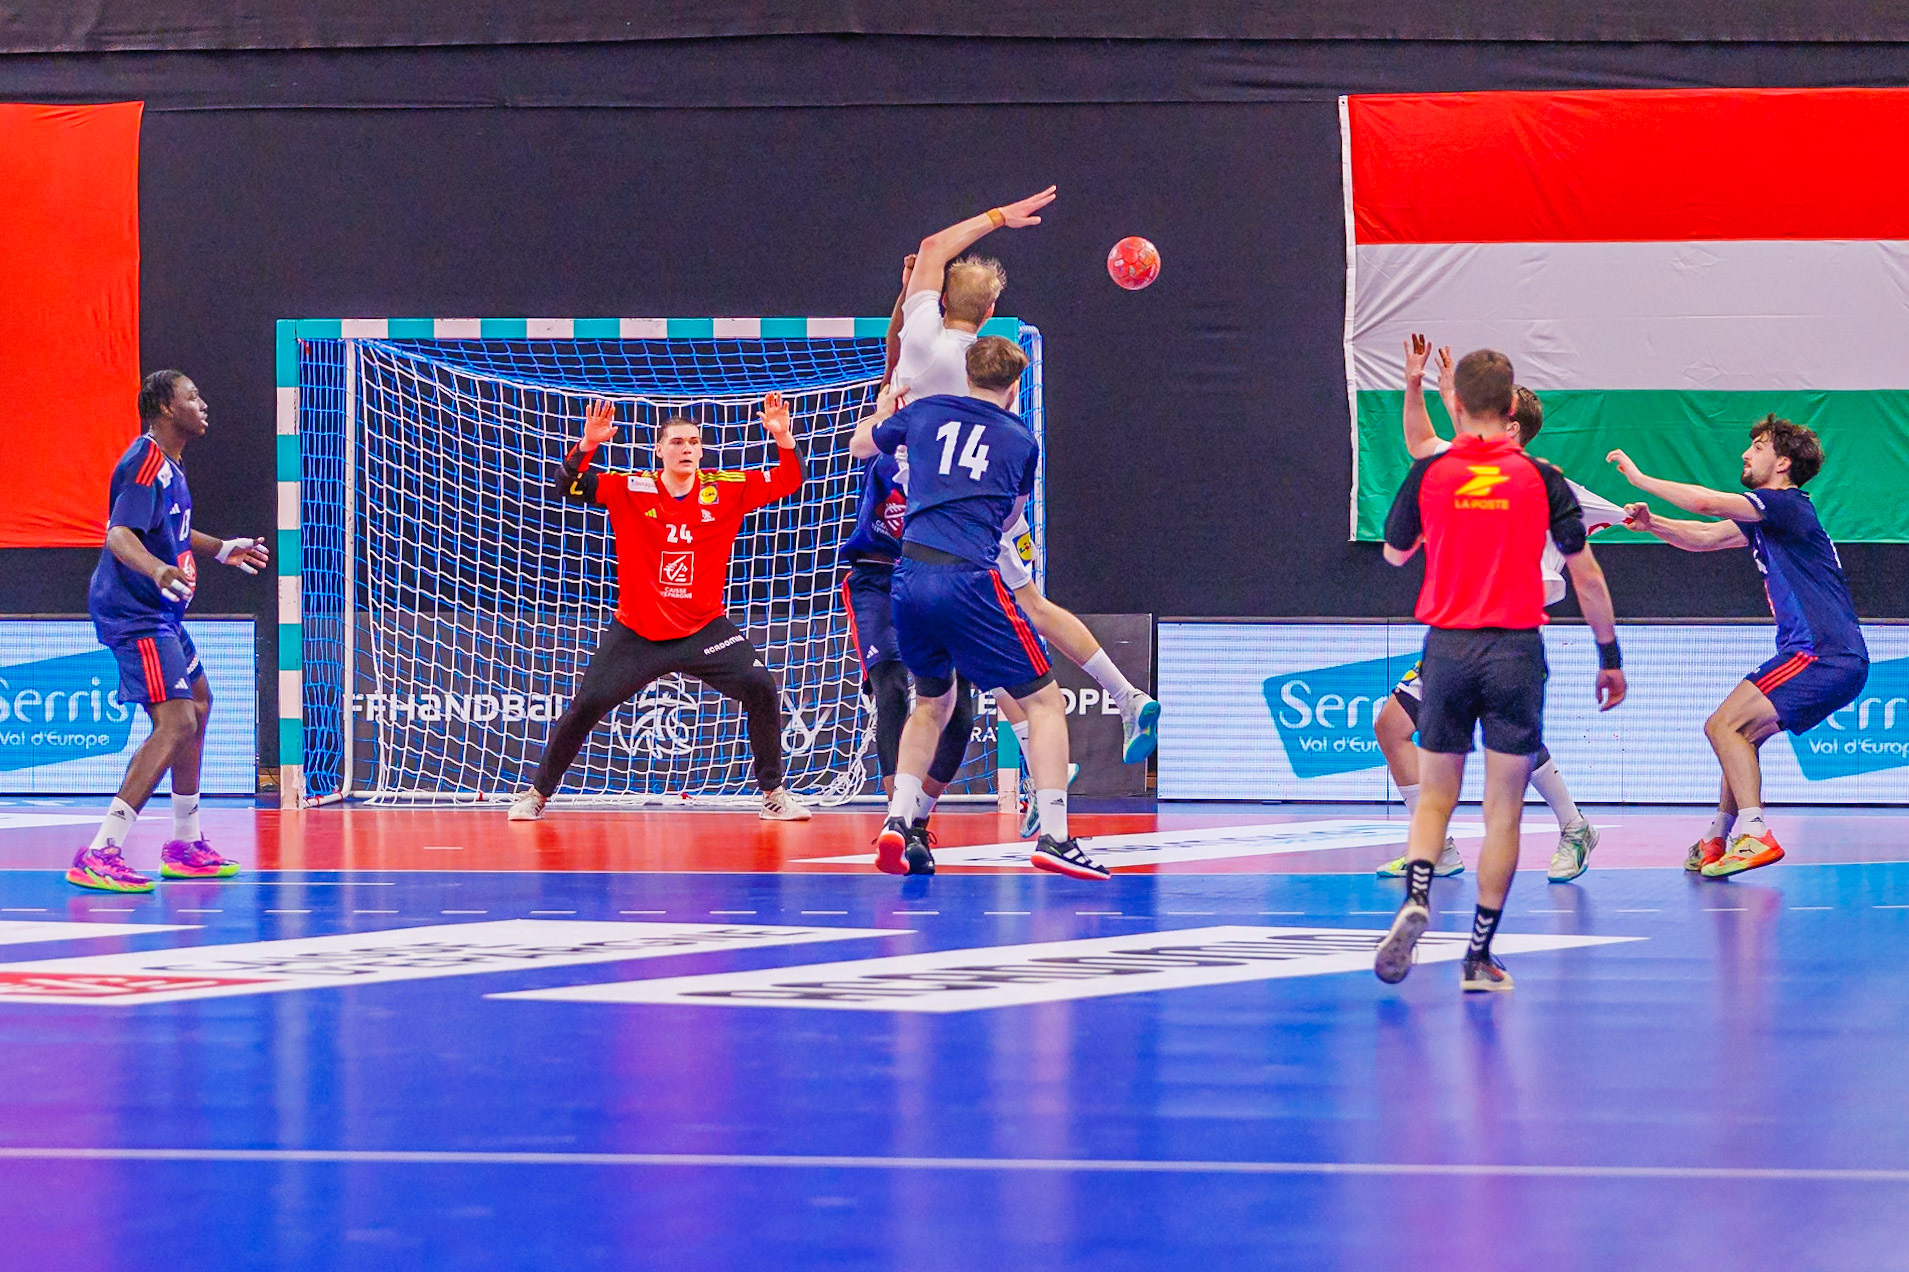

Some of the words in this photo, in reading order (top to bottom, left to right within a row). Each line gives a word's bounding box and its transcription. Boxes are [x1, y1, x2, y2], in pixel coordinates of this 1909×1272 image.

[936, 421, 990, 481] 14
[665, 524, 693, 543] 24
[0, 676, 129, 723] erris
[0, 731, 25, 746] Val
[1299, 736, 1327, 752] Val
[1808, 738, 1838, 754] Val
